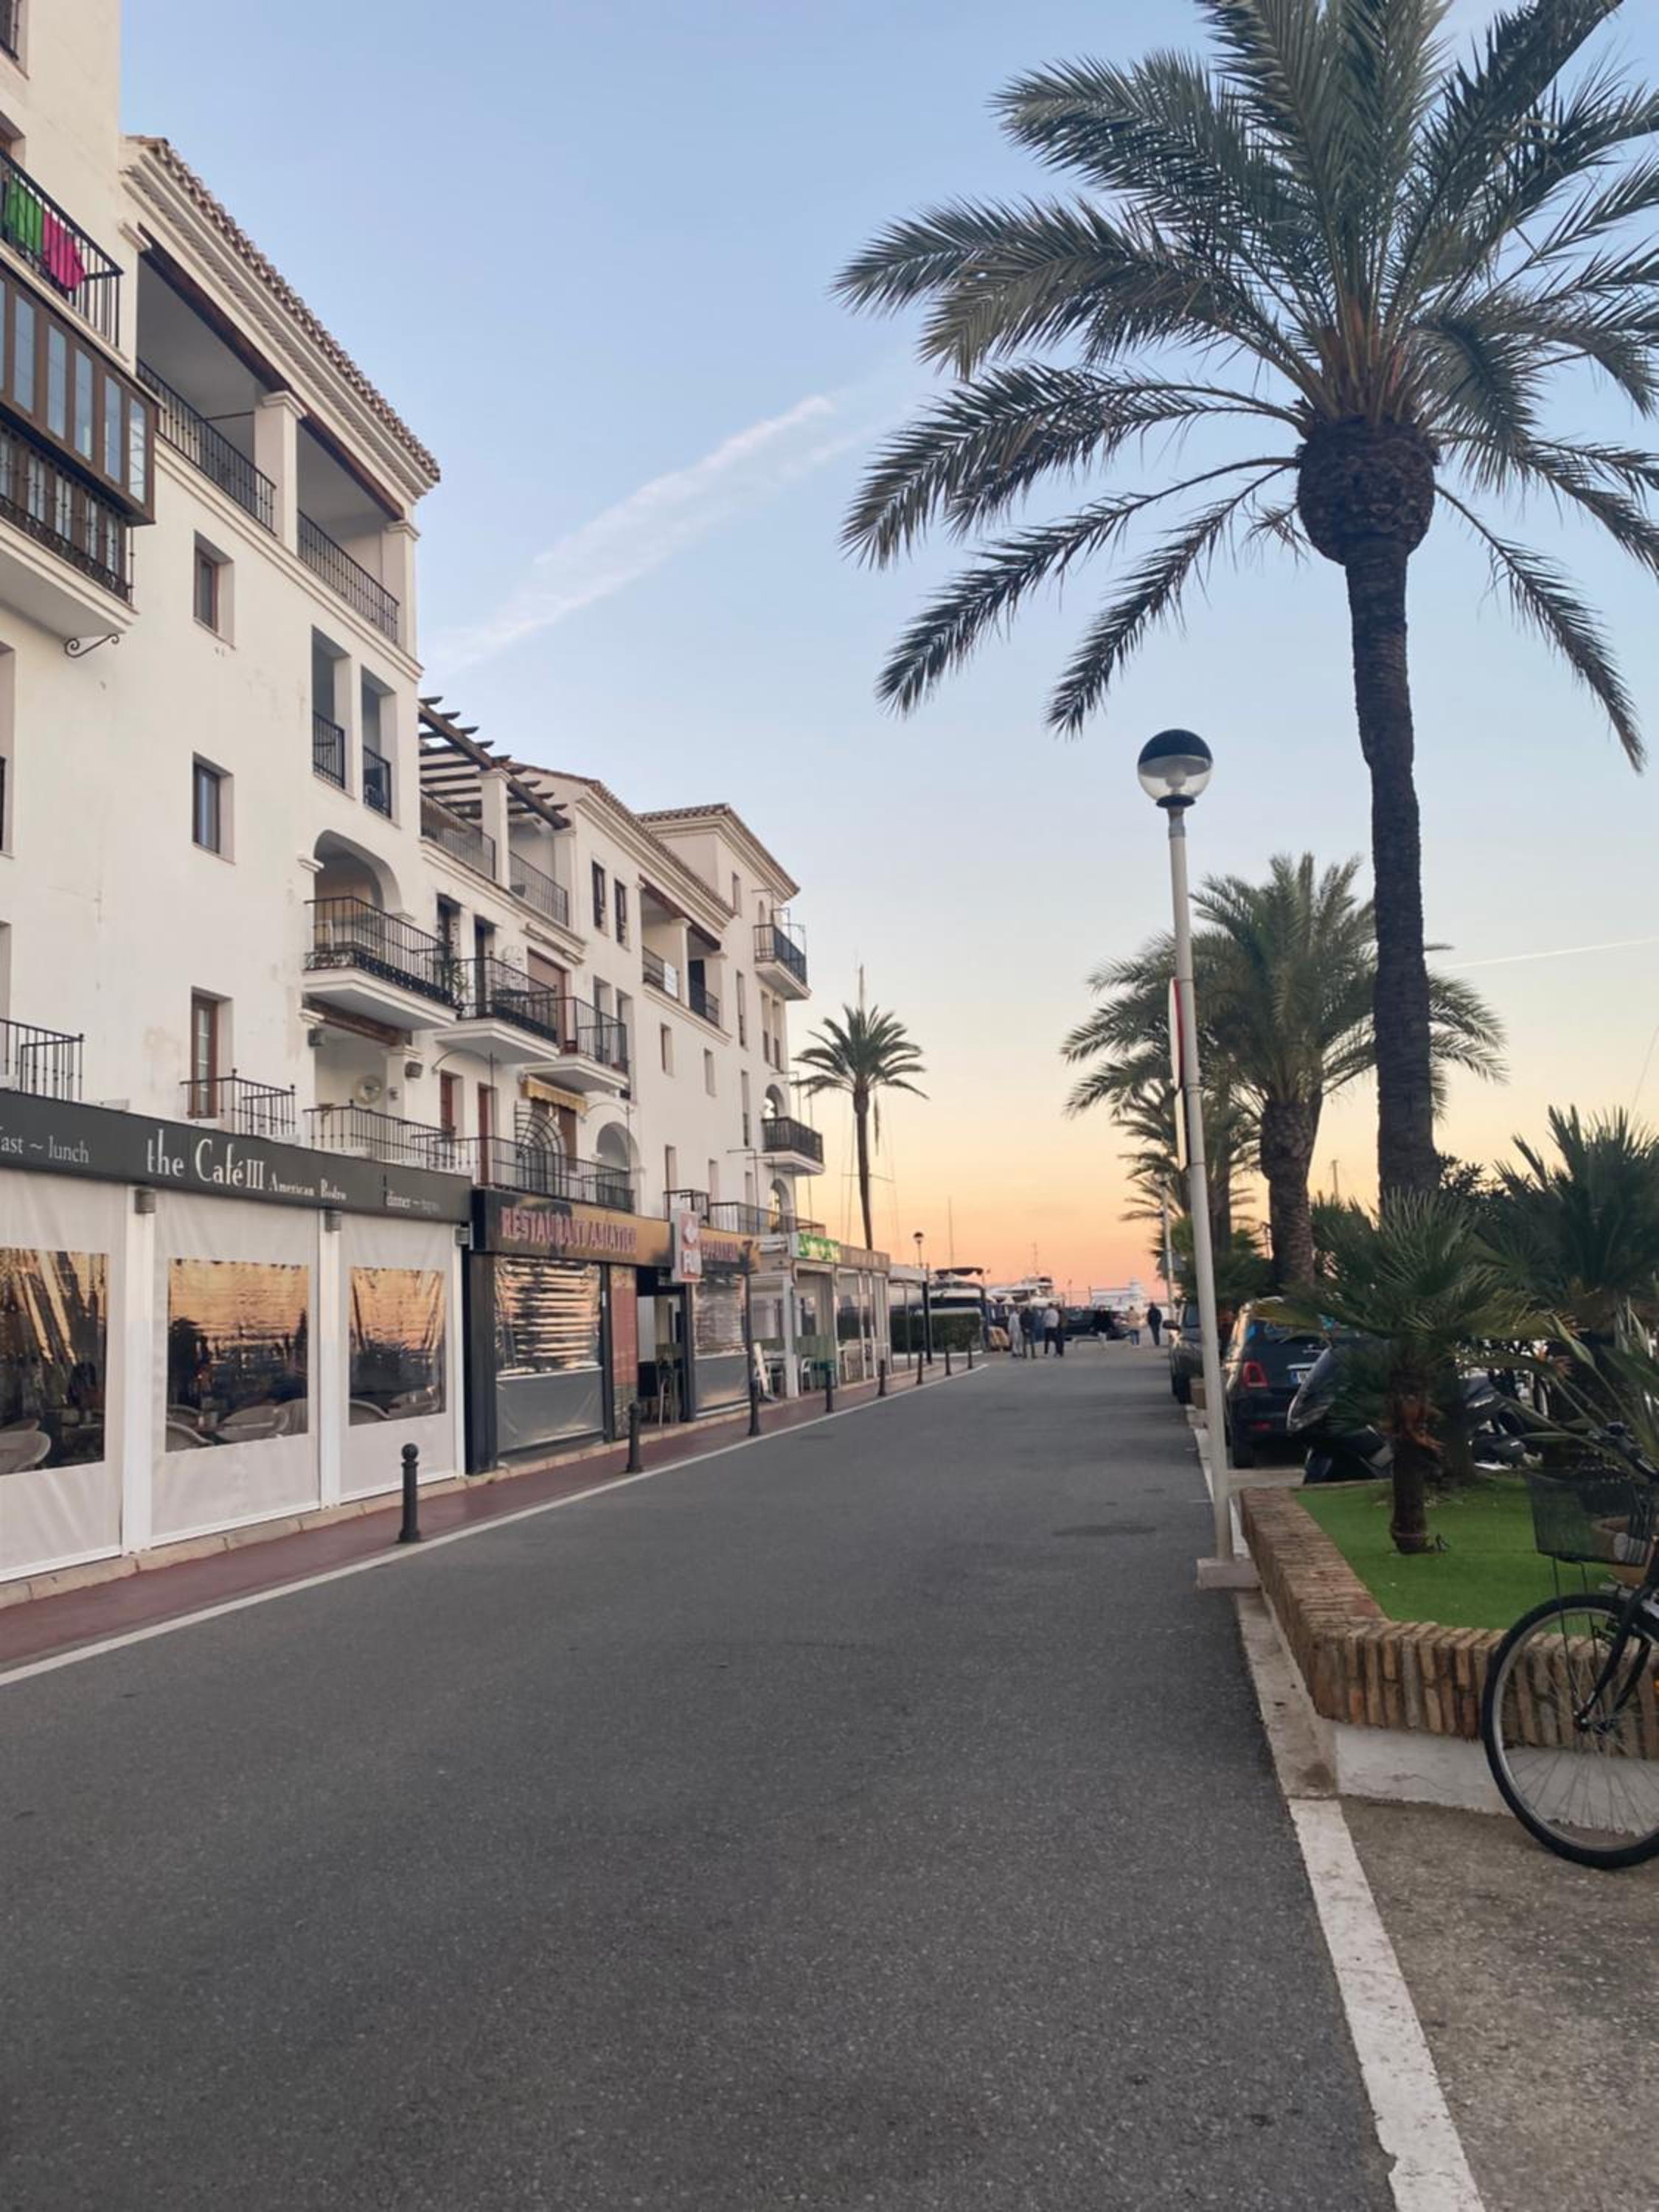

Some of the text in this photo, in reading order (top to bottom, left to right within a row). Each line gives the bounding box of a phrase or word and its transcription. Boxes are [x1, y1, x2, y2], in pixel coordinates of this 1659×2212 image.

[48, 1135, 89, 1164] lunch
[147, 1128, 184, 1177] the
[268, 1172, 315, 1196] American
